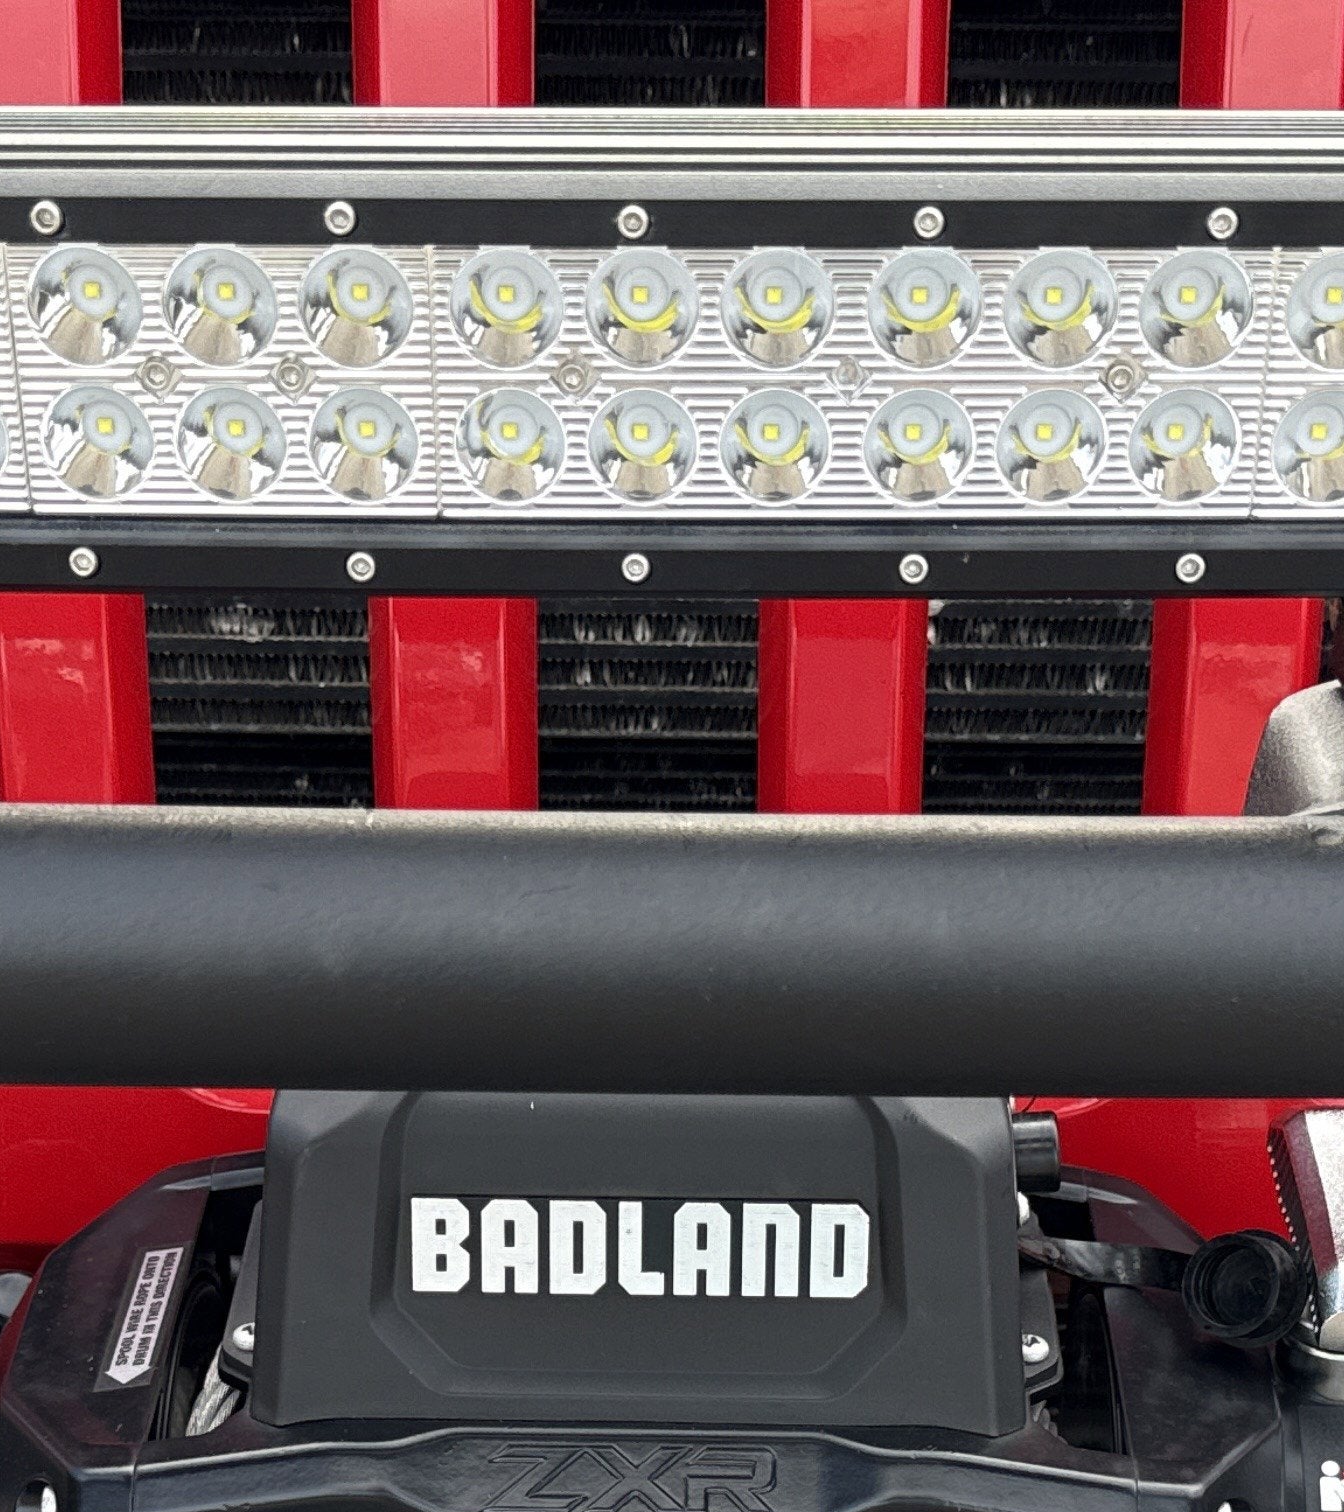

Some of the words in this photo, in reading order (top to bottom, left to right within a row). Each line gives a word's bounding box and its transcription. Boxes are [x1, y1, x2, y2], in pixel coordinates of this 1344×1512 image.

[410, 1197, 870, 1299] BADLAND
[115, 1334, 136, 1366] SPOOL
[126, 1308, 144, 1333] WIRE
[142, 1255, 160, 1280] ONTO
[132, 1336, 152, 1366] DRUM
